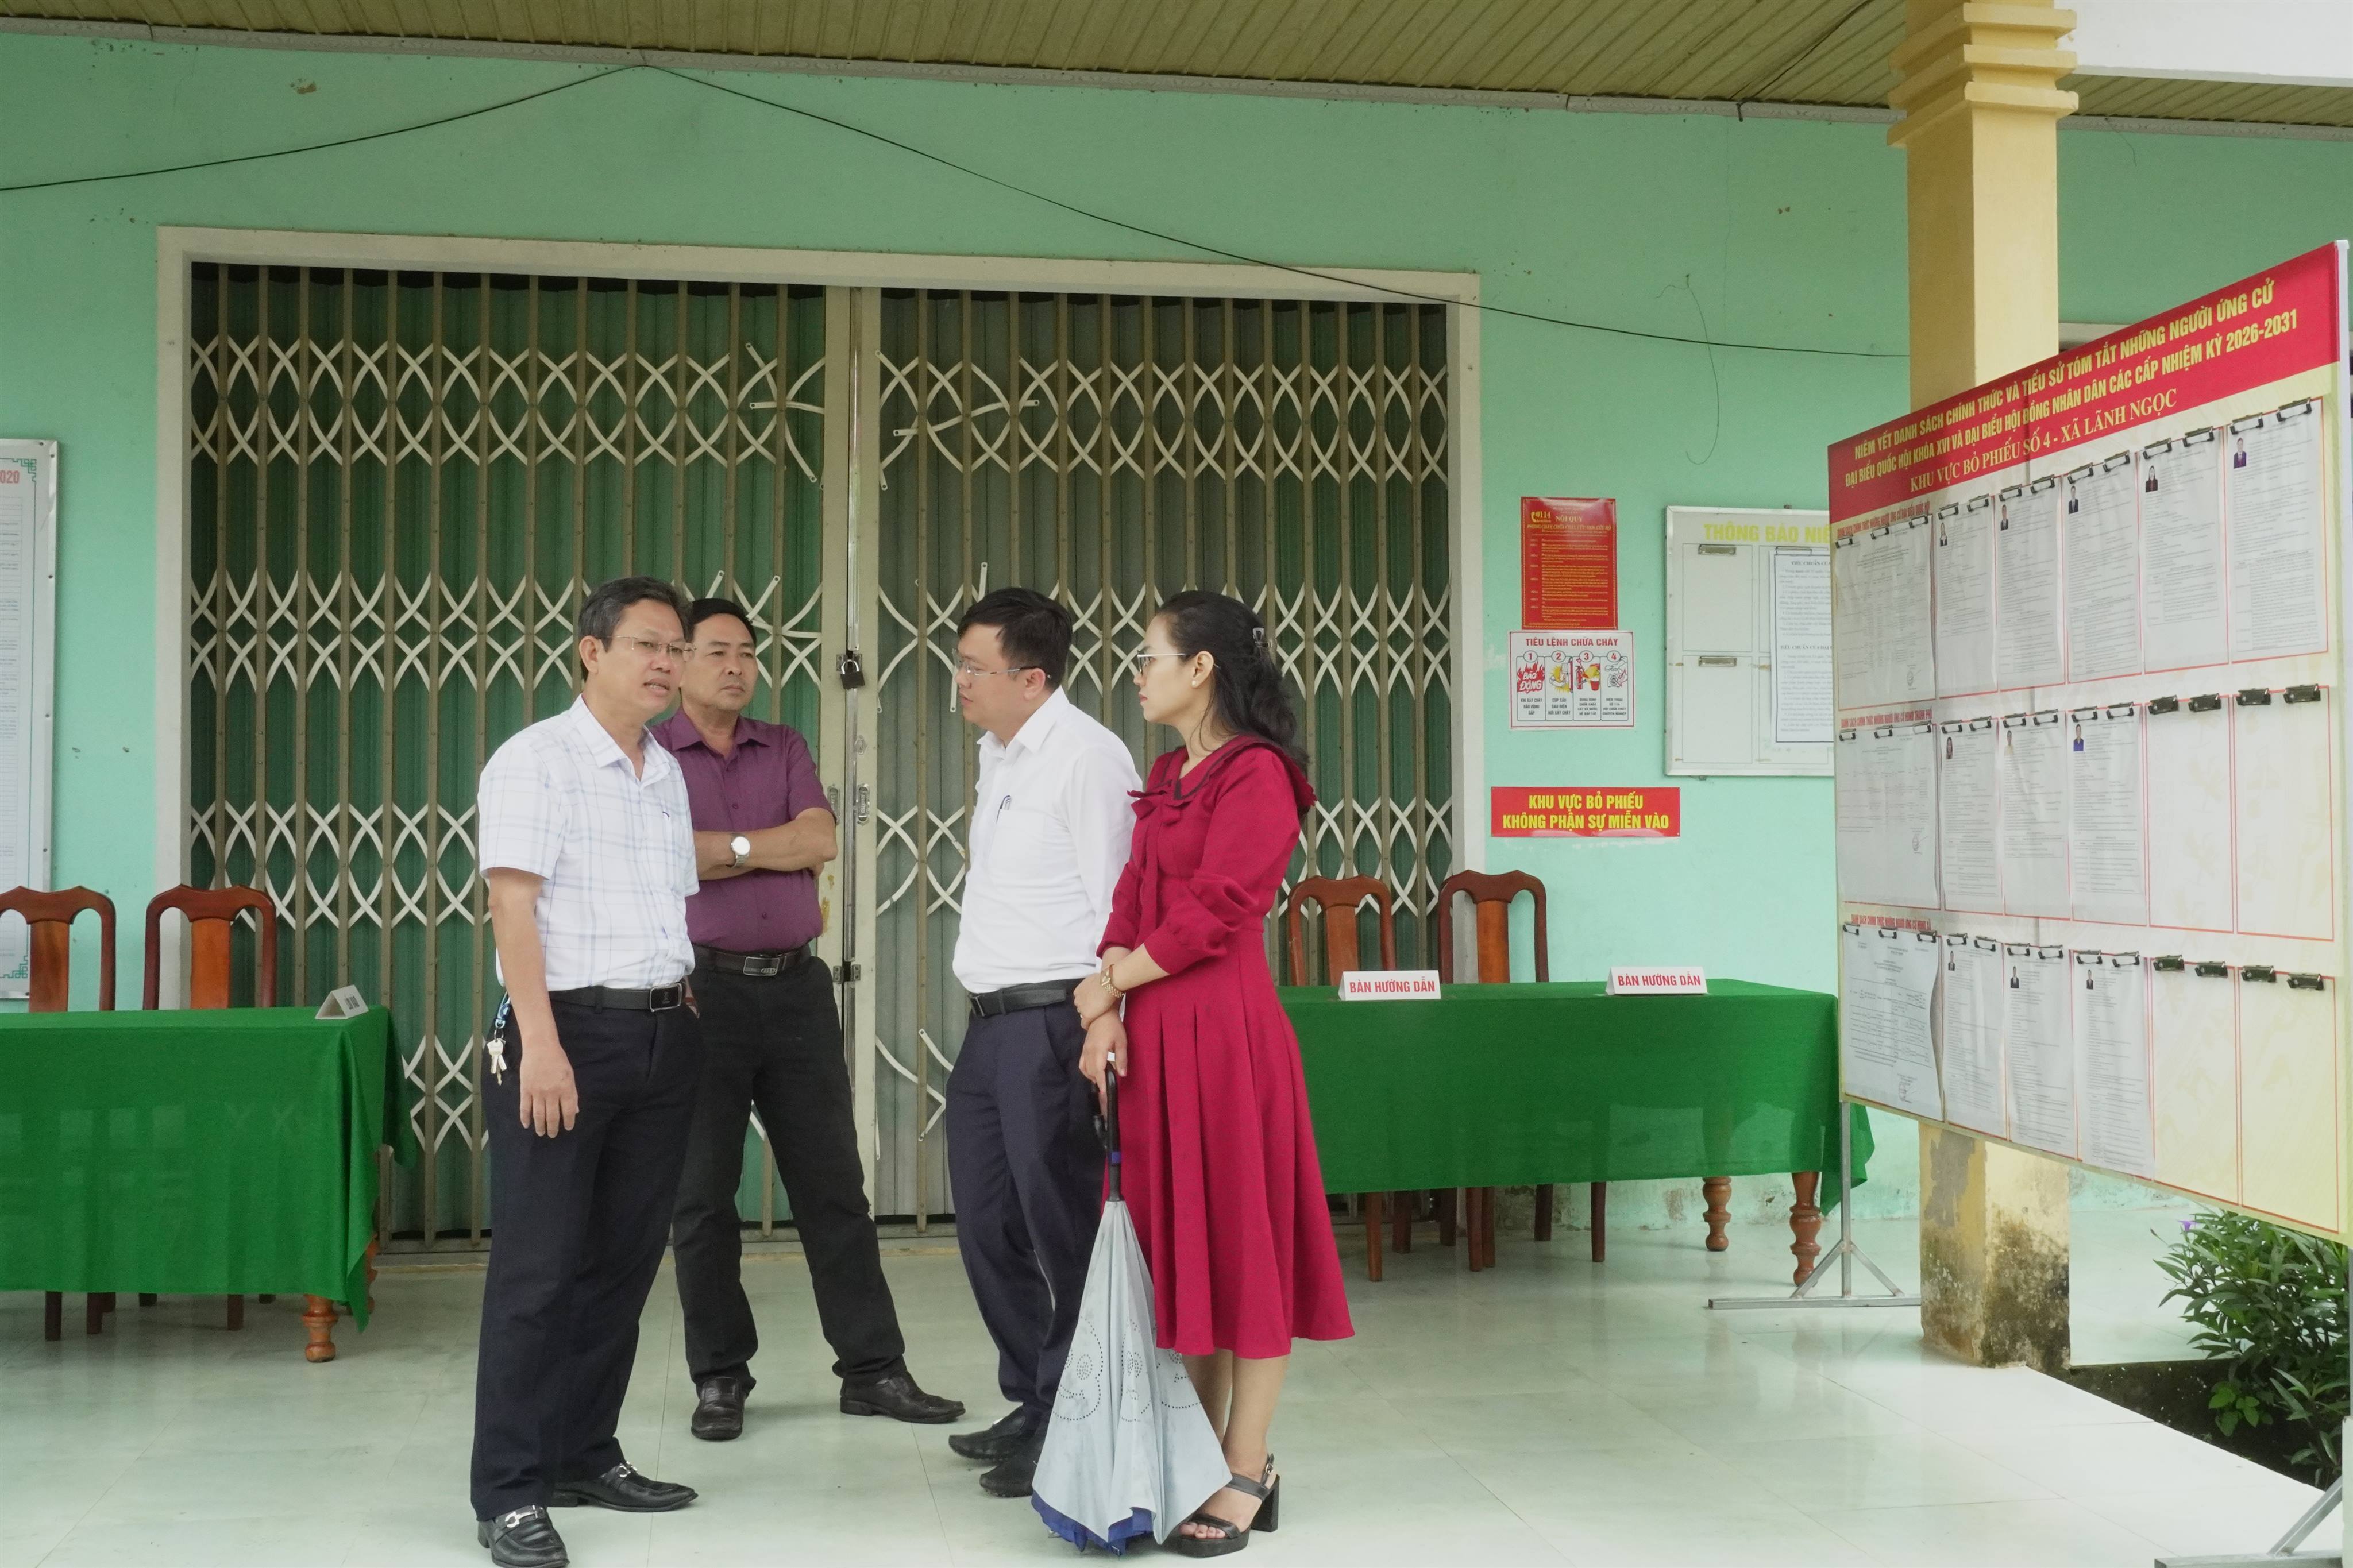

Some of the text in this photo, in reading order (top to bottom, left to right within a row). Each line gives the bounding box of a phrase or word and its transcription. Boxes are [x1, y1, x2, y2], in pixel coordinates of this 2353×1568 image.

[1855, 277, 2275, 459] NIÊM YẾT DANH SÁCH CHÍNH THỨC VÀ TIỂU SỬ TÓM TẮT NHỮNG NGƯỜI ỨNG CỬ
[1845, 308, 2297, 488] ĐẠI BIỂU QUỐC HỘI KHÓA XVI VÀ ĐẠI BIỂU HỘI ĐỒNG NHÂN DÂN CÁC CẤP NHIỆM KỲ 2026-2031
[1911, 471, 1934, 492] KHU
[1937, 461, 1961, 486] VỰC
[1964, 451, 1980, 476] BỎ
[1982, 437, 2020, 469] PHIẾU
[2023, 427, 2040, 456] SỐ
[2043, 432, 2050, 448] 4
[2061, 416, 2081, 443] XÃ
[2084, 410, 2126, 435] LÃNH
[2130, 388, 2177, 420] NGỌC
[0, 470, 20, 484] 020
[1540, 511, 1552, 519] 114
[1704, 521, 1830, 543] THÔNG BÁO NIÊ
[1525, 636, 1618, 648] TIÊU LỆNH CHỮA CHÁY
[1522, 670, 1537, 680] BÁO
[1519, 679, 1542, 693] ĐỘNG
[1529, 791, 1644, 812] KHU VỰC BỎ PHIẾU
[1503, 810, 1669, 831] KHÔNG PHẬN SỰ MIỄN VÀO
[1350, 976, 1435, 993] BÀN HƯỚNG DẪN
[1618, 971, 1701, 986] BÀN HƯỚNG DẪN
